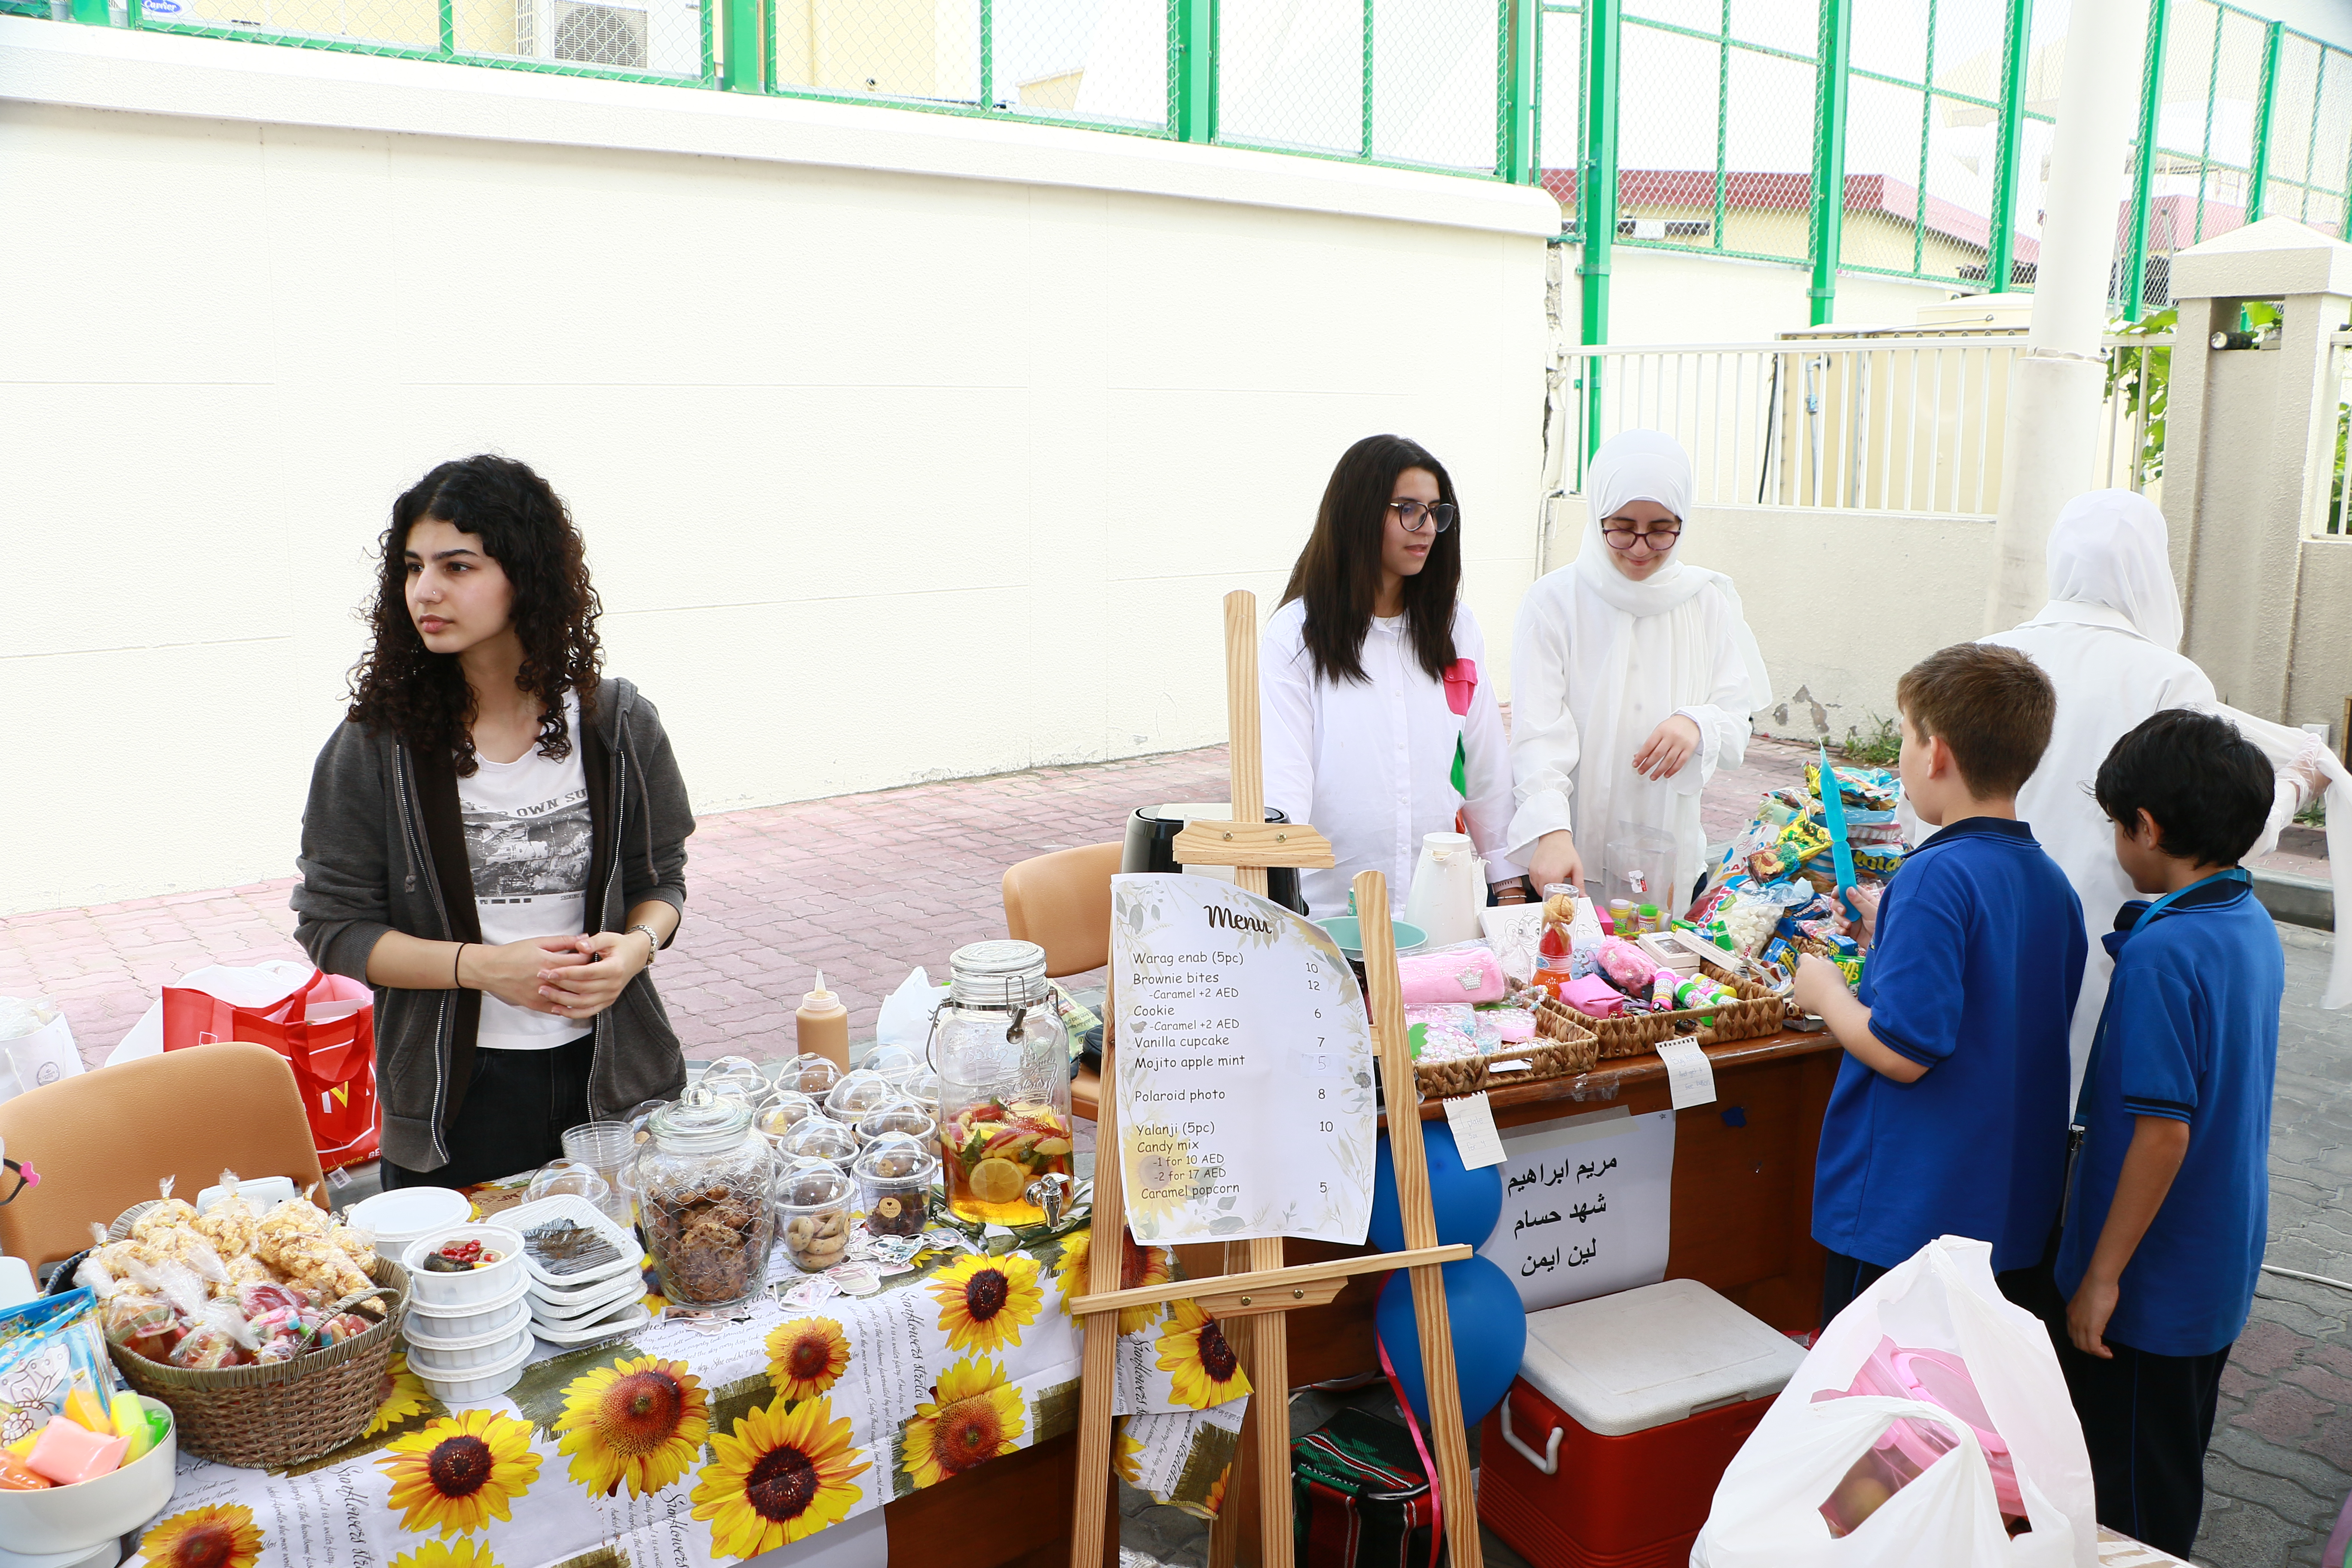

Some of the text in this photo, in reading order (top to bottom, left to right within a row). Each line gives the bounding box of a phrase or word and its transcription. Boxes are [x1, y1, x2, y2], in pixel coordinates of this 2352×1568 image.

[144, 0, 177, 11] Carrier
[517, 797, 559, 817] OWN
[1204, 905, 1272, 934] Menu
[1133, 951, 1243, 966] Warag enab (5pc)
[1306, 962, 1318, 973] 10
[1133, 972, 1219, 986] Brownie bites
[1308, 980, 1320, 991] 12
[1149, 987, 1238, 999] -Caramel +2 AED
[1134, 1004, 1175, 1016] Cookie
[1315, 1008, 1321, 1018] 6
[1150, 1019, 1239, 1030] -Caramel +2 AED
[1135, 1035, 1229, 1049] Vanilla cupcake
[1317, 1037, 1325, 1047] 7
[1133, 1055, 1245, 1073] Mojito apple mint
[1318, 1056, 1326, 1070] 5
[1134, 1089, 1225, 1103] Polaroid photo
[1318, 1089, 1325, 1099] 8
[1136, 1121, 1214, 1137] Yalanji (5pc)
[1320, 1121, 1333, 1132] 10
[1467, 1116, 1483, 1130] plate
[1137, 1139, 1199, 1155] Candy mix
[1153, 1154, 1225, 1167] -1 for 10 AED
[1154, 1169, 1226, 1182] -2 for 17 AED
[1507, 1158, 1617, 1198] مريم ابراهيم
[1141, 1184, 1240, 1200] Caramel popcorn
[1320, 1182, 1327, 1194] 5
[1514, 1193, 1606, 1240] شهد حسام
[1522, 1237, 1596, 1277] لين ايمن
[887, 1291, 925, 1364] Sunflowers
[1128, 1332, 1153, 1406] Sunflowers
[1164, 1440, 1189, 1499] stretched
[326, 1465, 369, 1544] Sunflowers
[659, 1487, 690, 1568] Sunflowers
